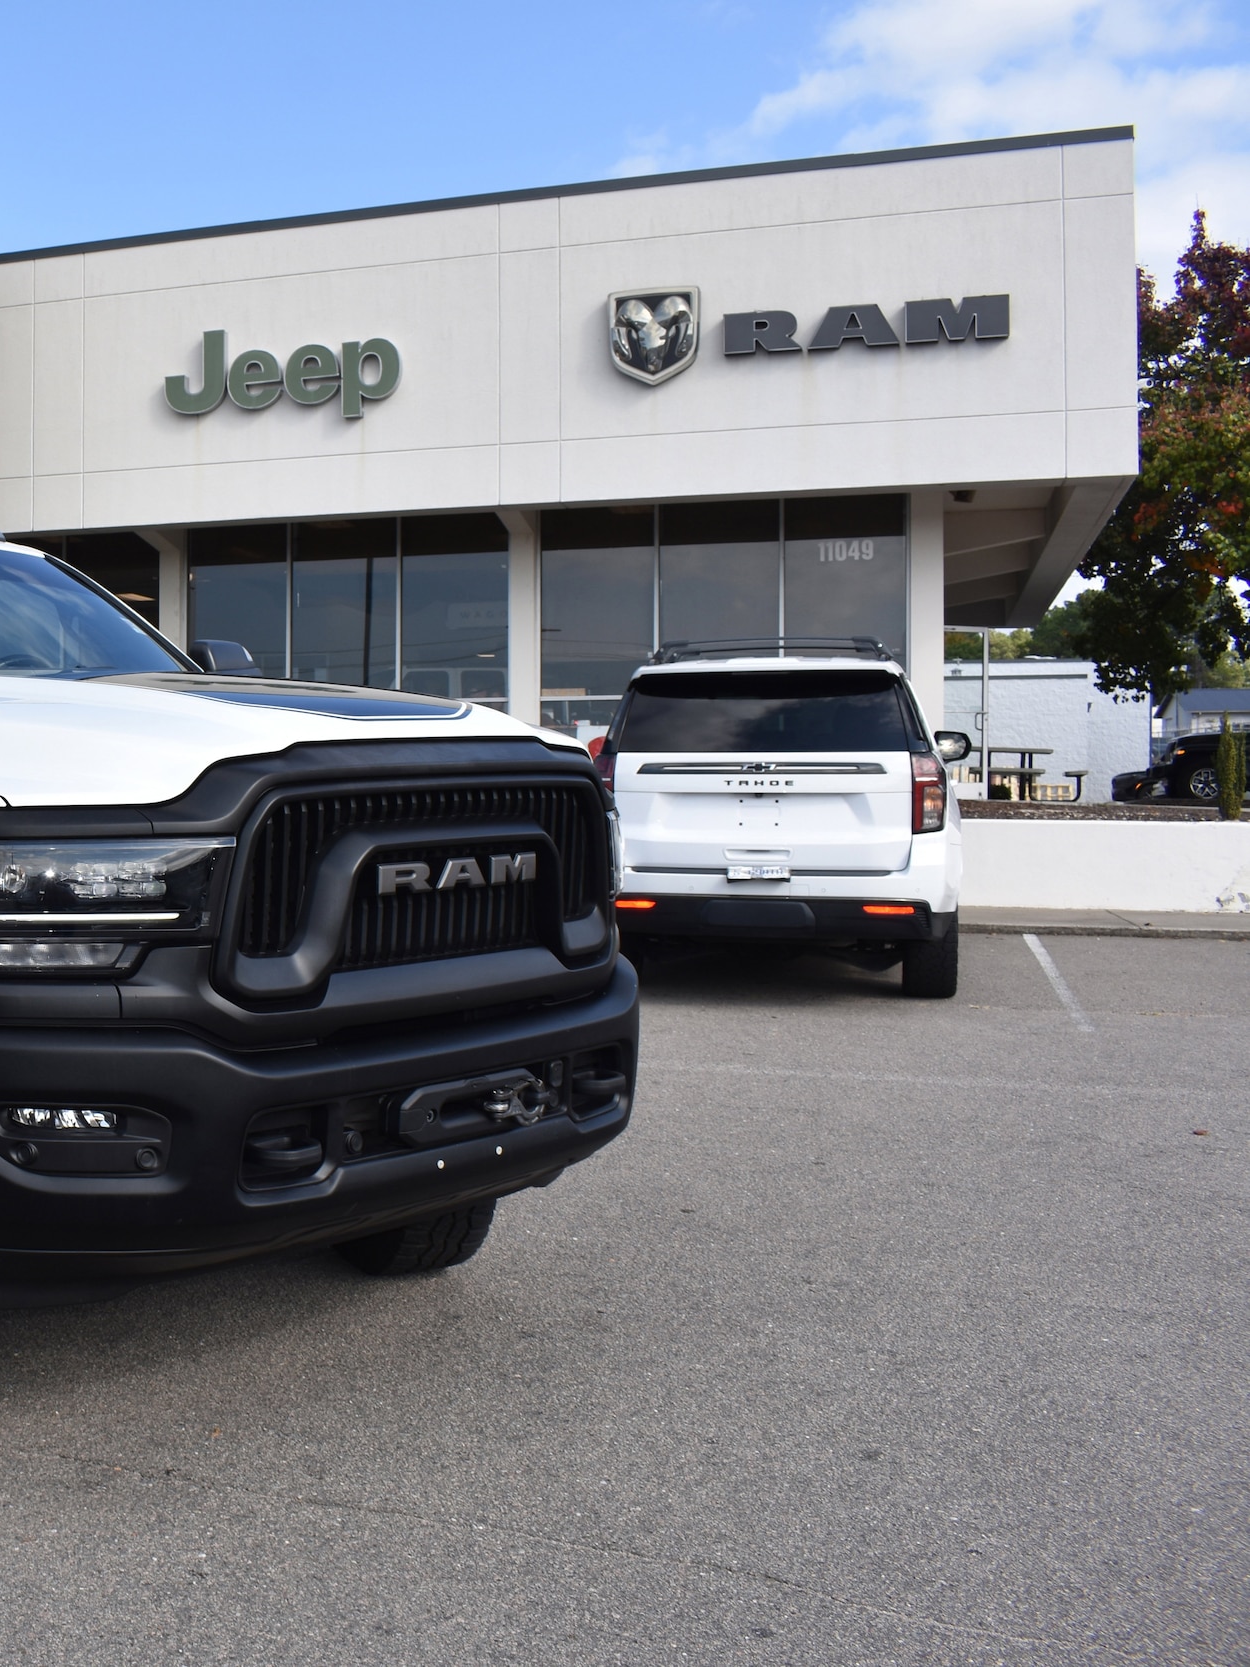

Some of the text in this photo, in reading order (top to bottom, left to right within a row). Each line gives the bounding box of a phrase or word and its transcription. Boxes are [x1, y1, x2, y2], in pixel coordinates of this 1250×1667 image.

[723, 293, 1010, 356] RAM
[164, 329, 402, 419] Jeep
[817, 539, 874, 562] 11049
[377, 851, 537, 896] RAM
